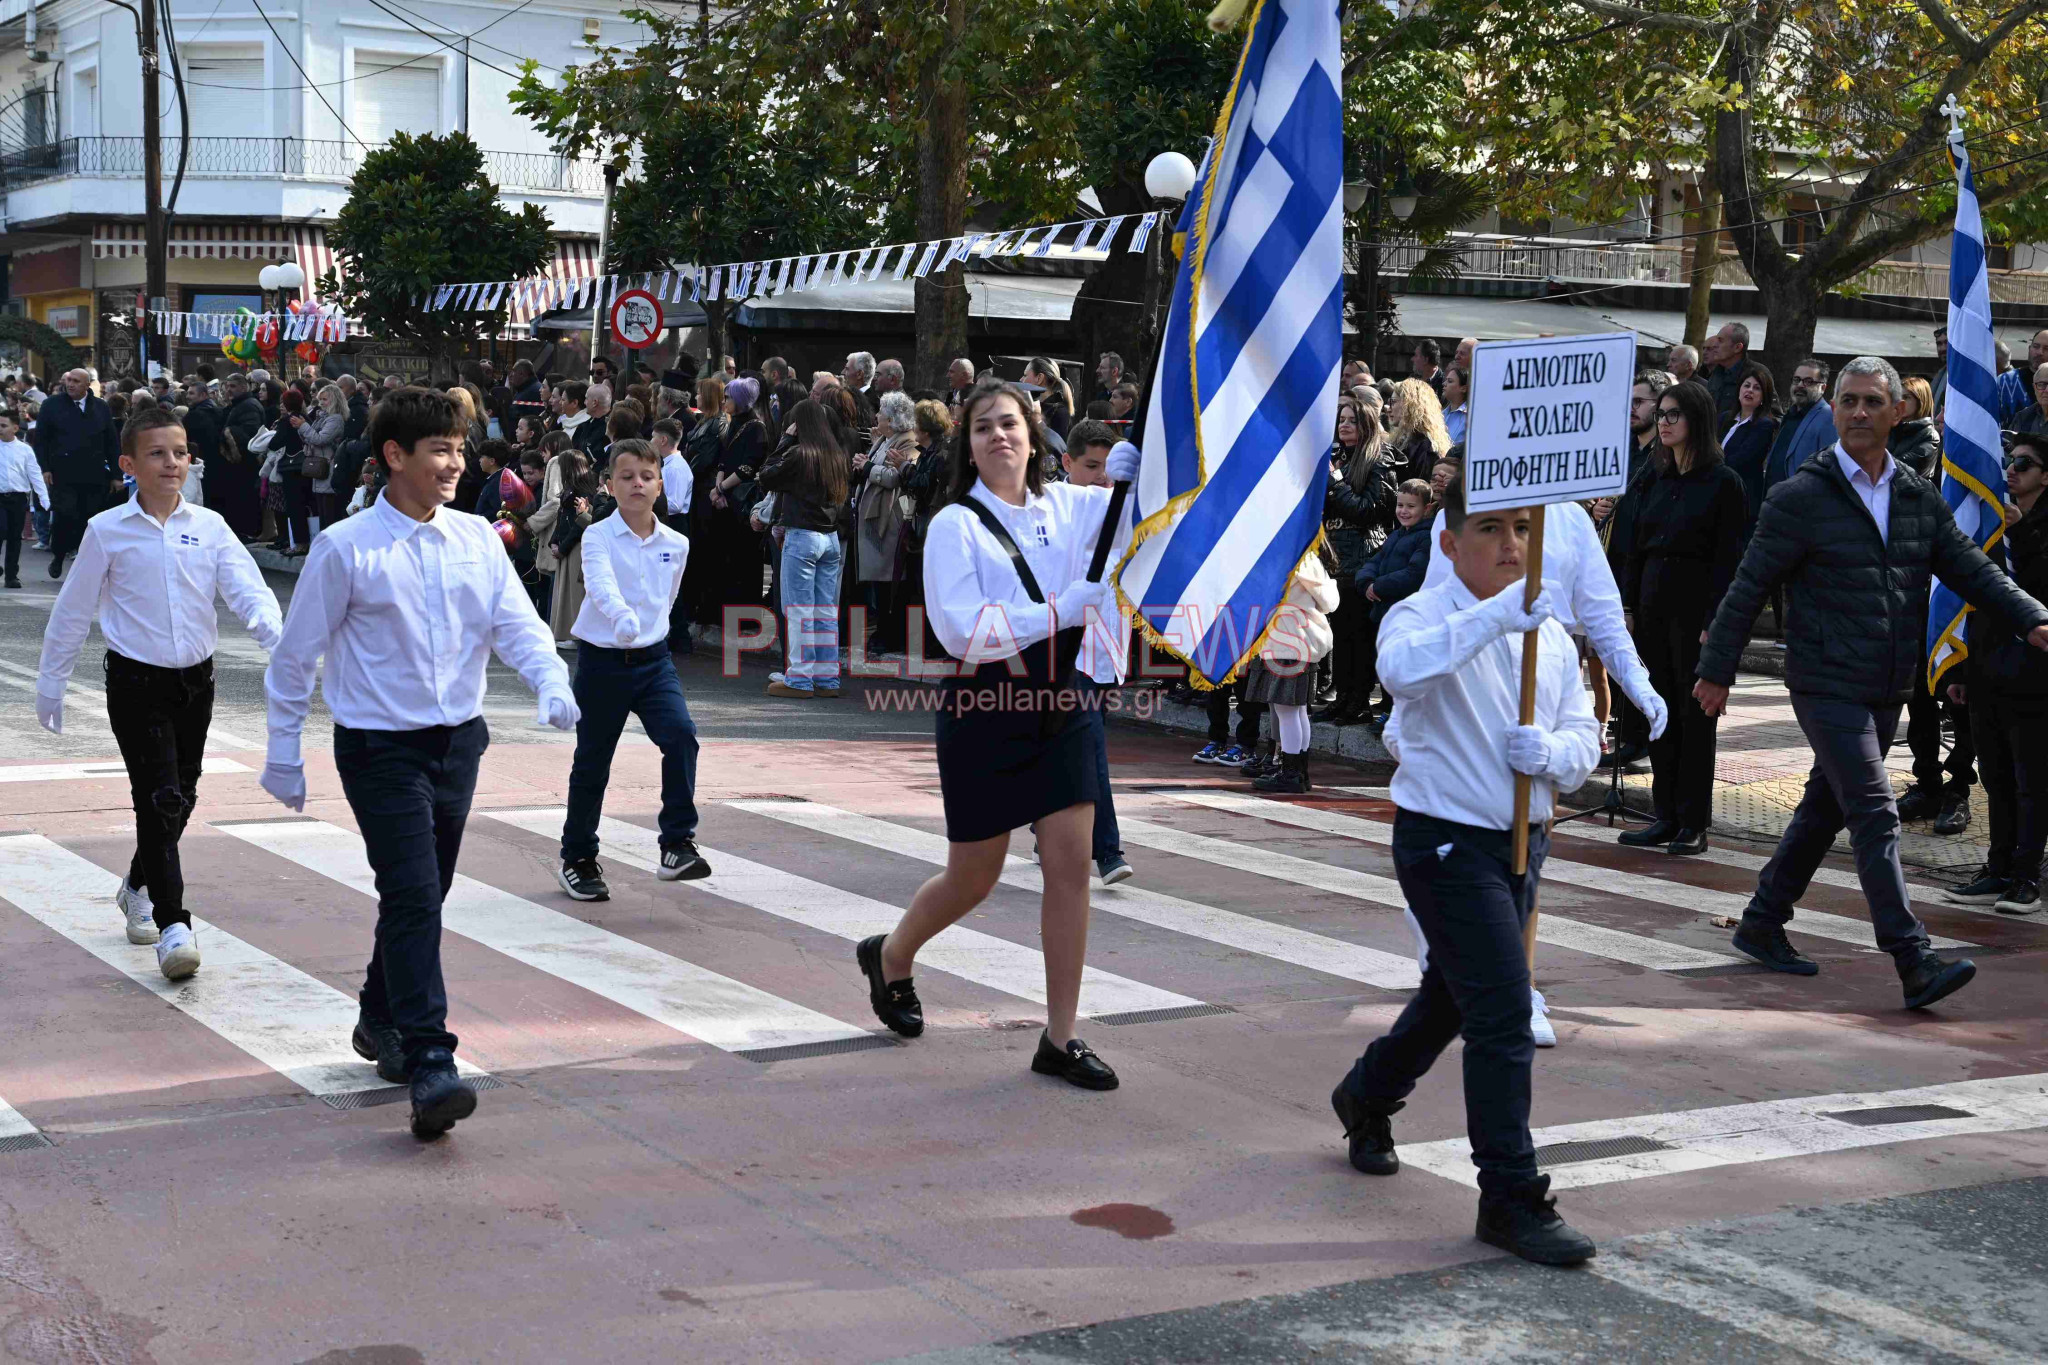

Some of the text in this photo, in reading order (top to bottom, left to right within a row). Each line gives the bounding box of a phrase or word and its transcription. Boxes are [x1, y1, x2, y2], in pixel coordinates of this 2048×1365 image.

[1502, 351, 1606, 391] ΔΗΜΟΤΙΚΟ
[1508, 400, 1594, 439] ΣΧΟΛΕΙΟ
[1471, 446, 1621, 492] ΠΡΟΦΗΤΗ ΗΛΙΑ
